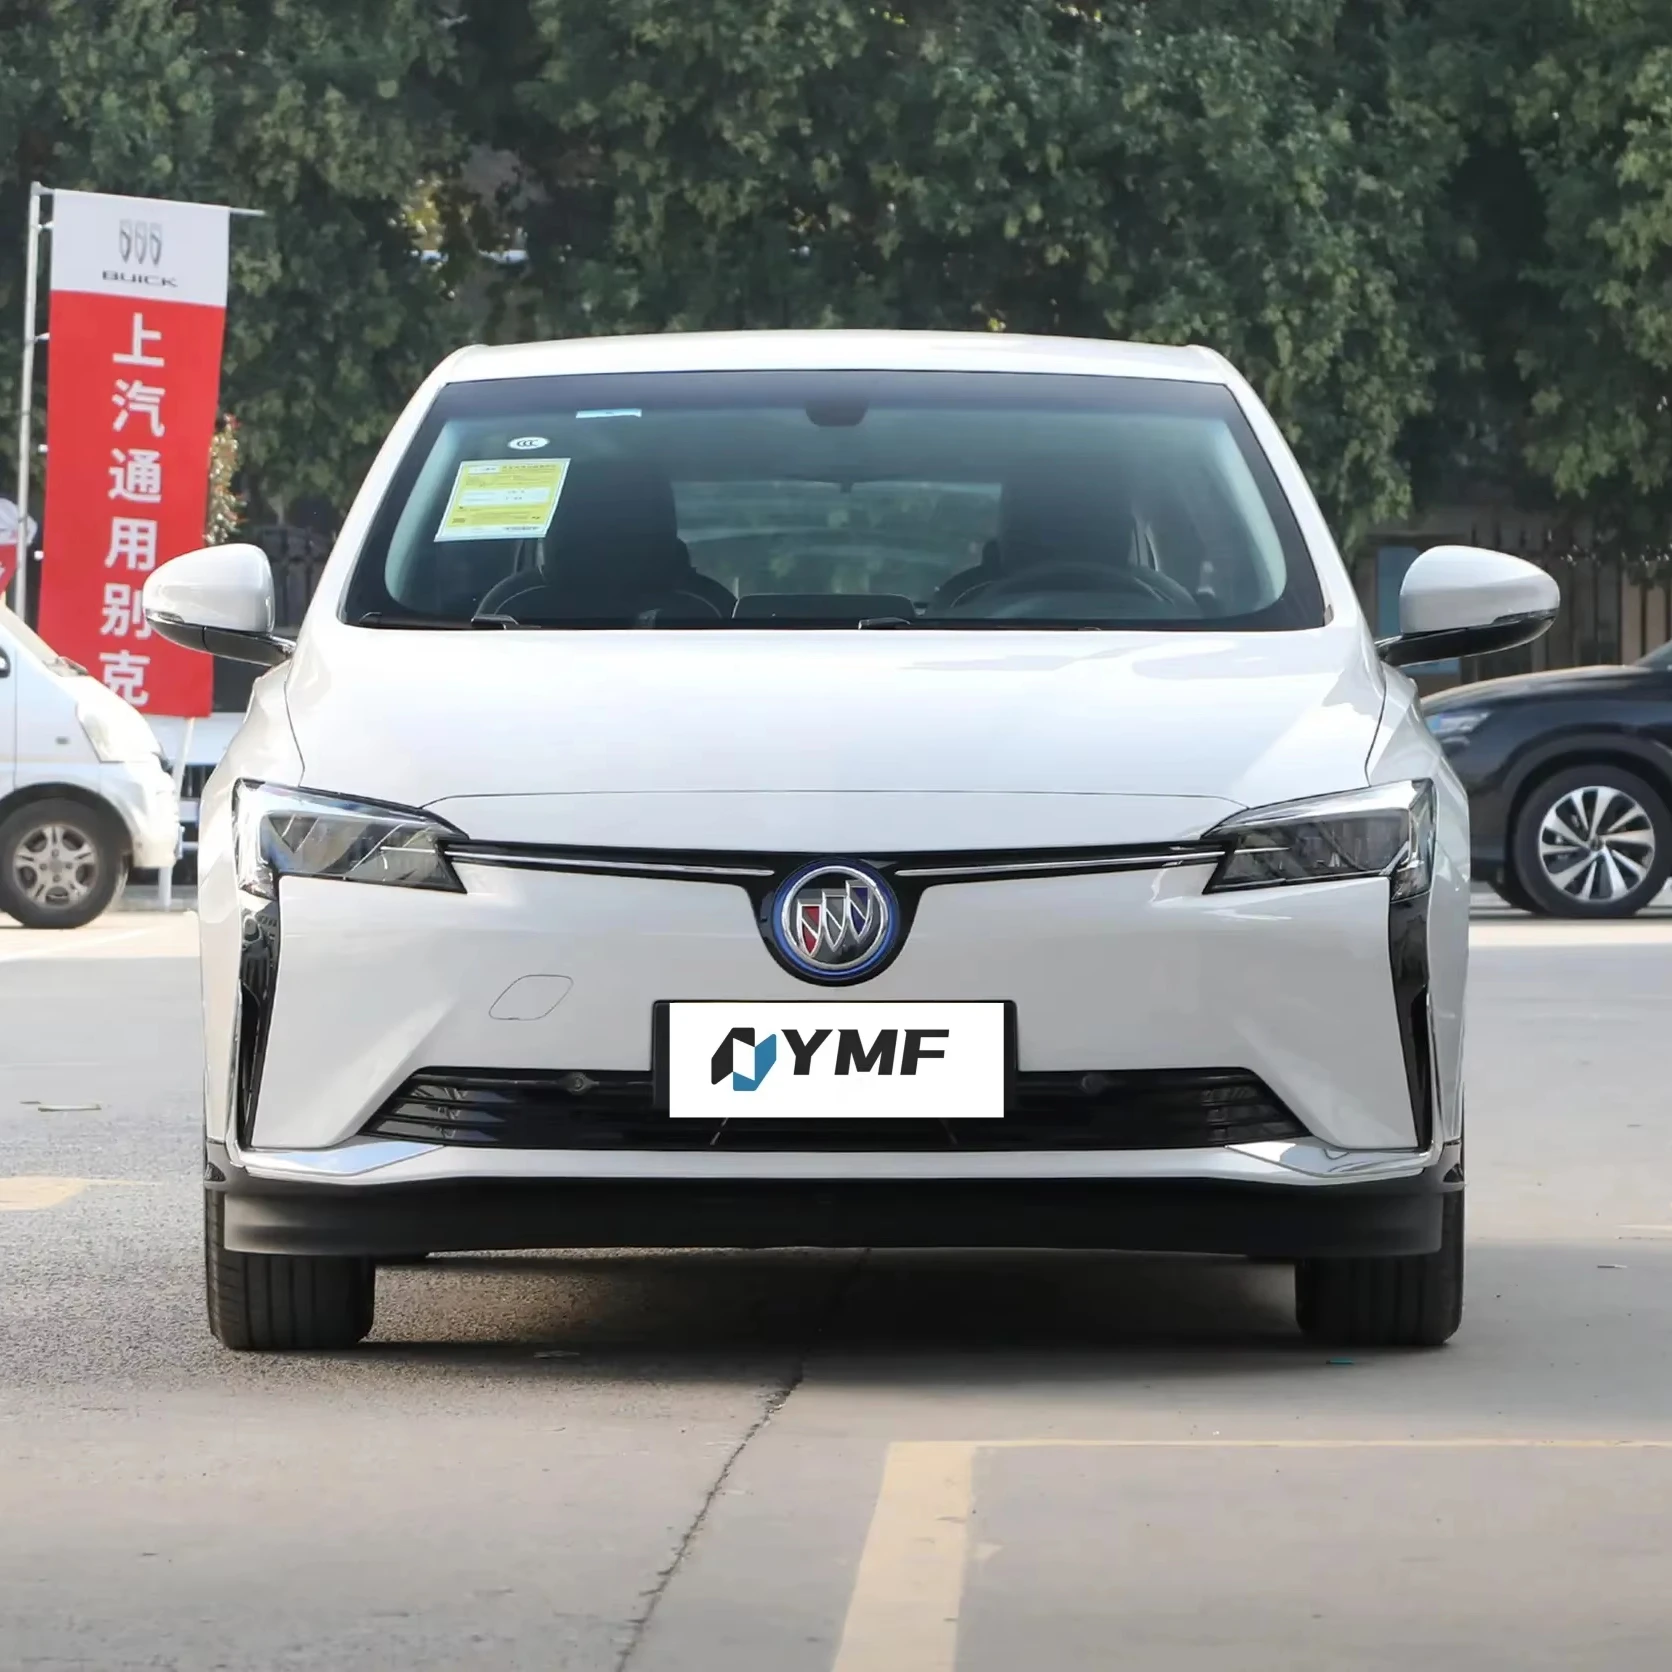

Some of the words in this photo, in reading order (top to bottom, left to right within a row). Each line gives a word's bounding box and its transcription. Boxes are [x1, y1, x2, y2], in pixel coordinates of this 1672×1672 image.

[102, 270, 178, 287] BUICK
[99, 312, 165, 706] 上汽通用别克
